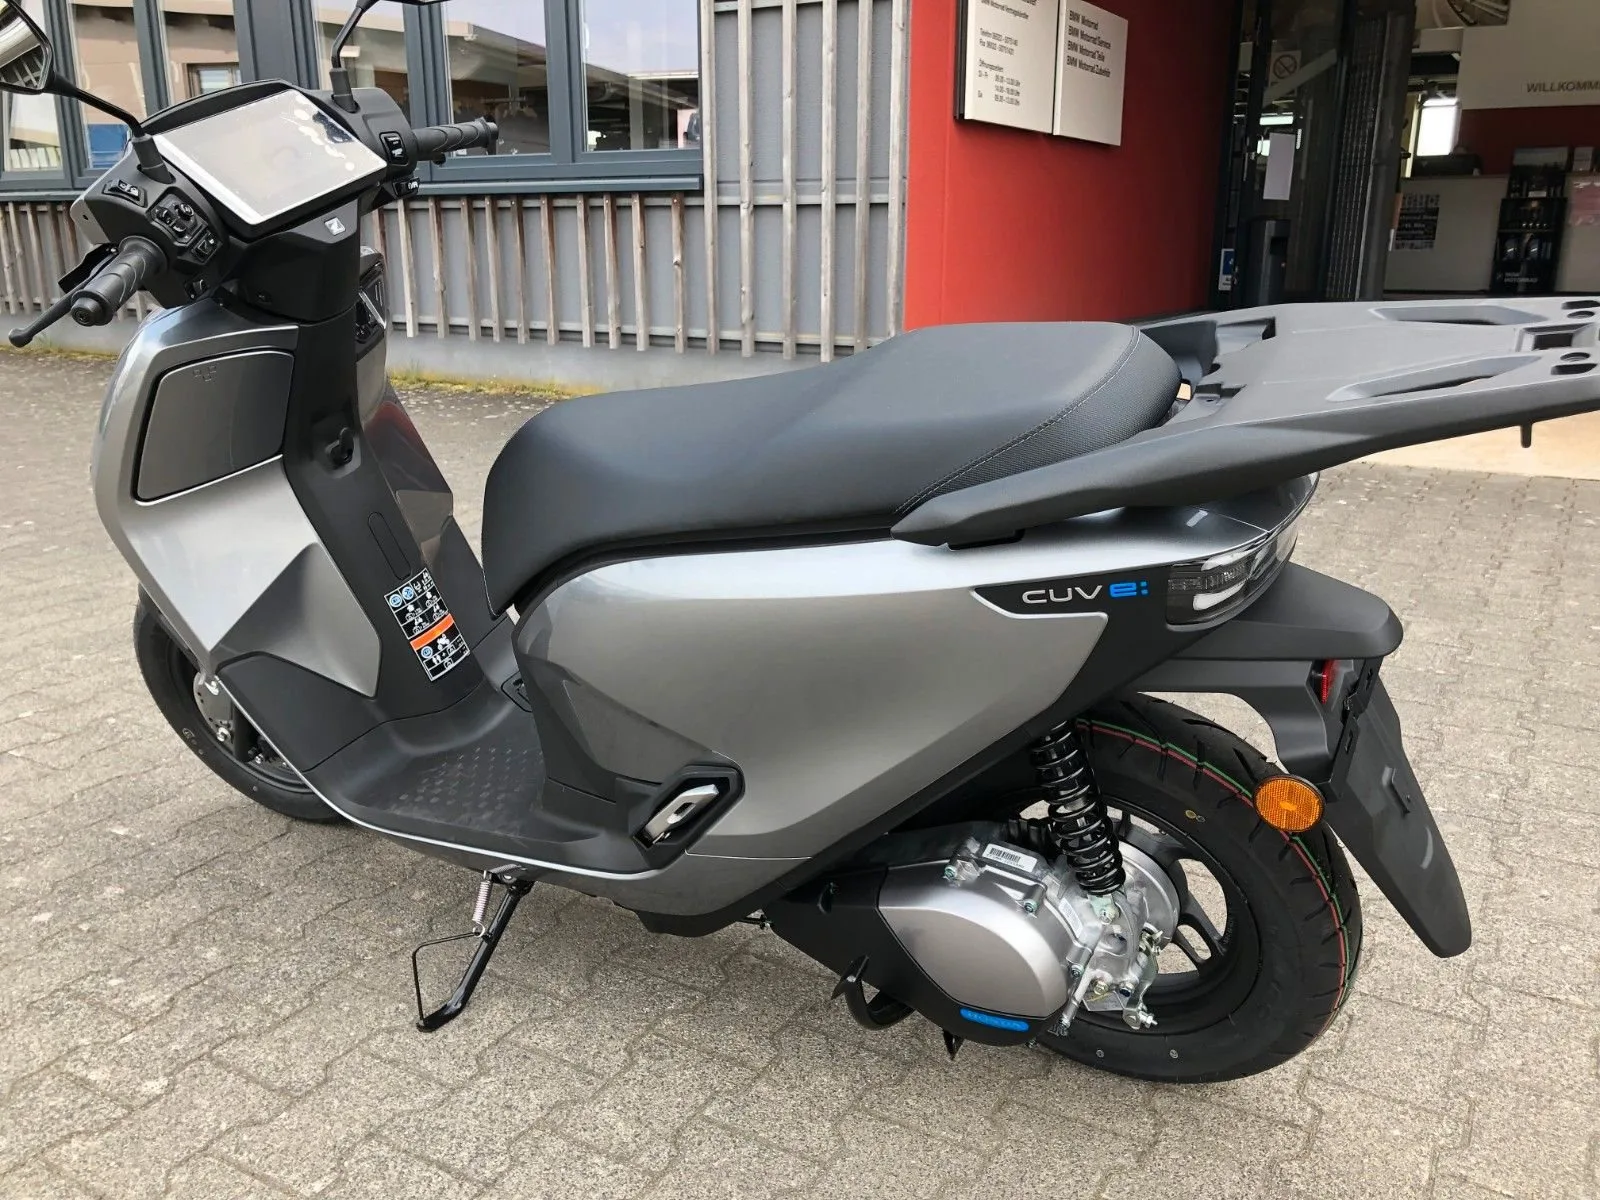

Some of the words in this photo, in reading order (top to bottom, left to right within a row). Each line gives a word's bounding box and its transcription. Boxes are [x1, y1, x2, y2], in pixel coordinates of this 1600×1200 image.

[1069, 10, 1080, 23] BMW
[1081, 15, 1098, 31] Motorrad
[1068, 25, 1079, 38] BMW
[1080, 29, 1098, 45] Motorrad
[1067, 40, 1078, 53] BMW
[1079, 44, 1097, 60] Motorrad
[1067, 55, 1077, 68] BMW
[1078, 59, 1096, 74] Motorrad
[1022, 585, 1103, 604] CUV
